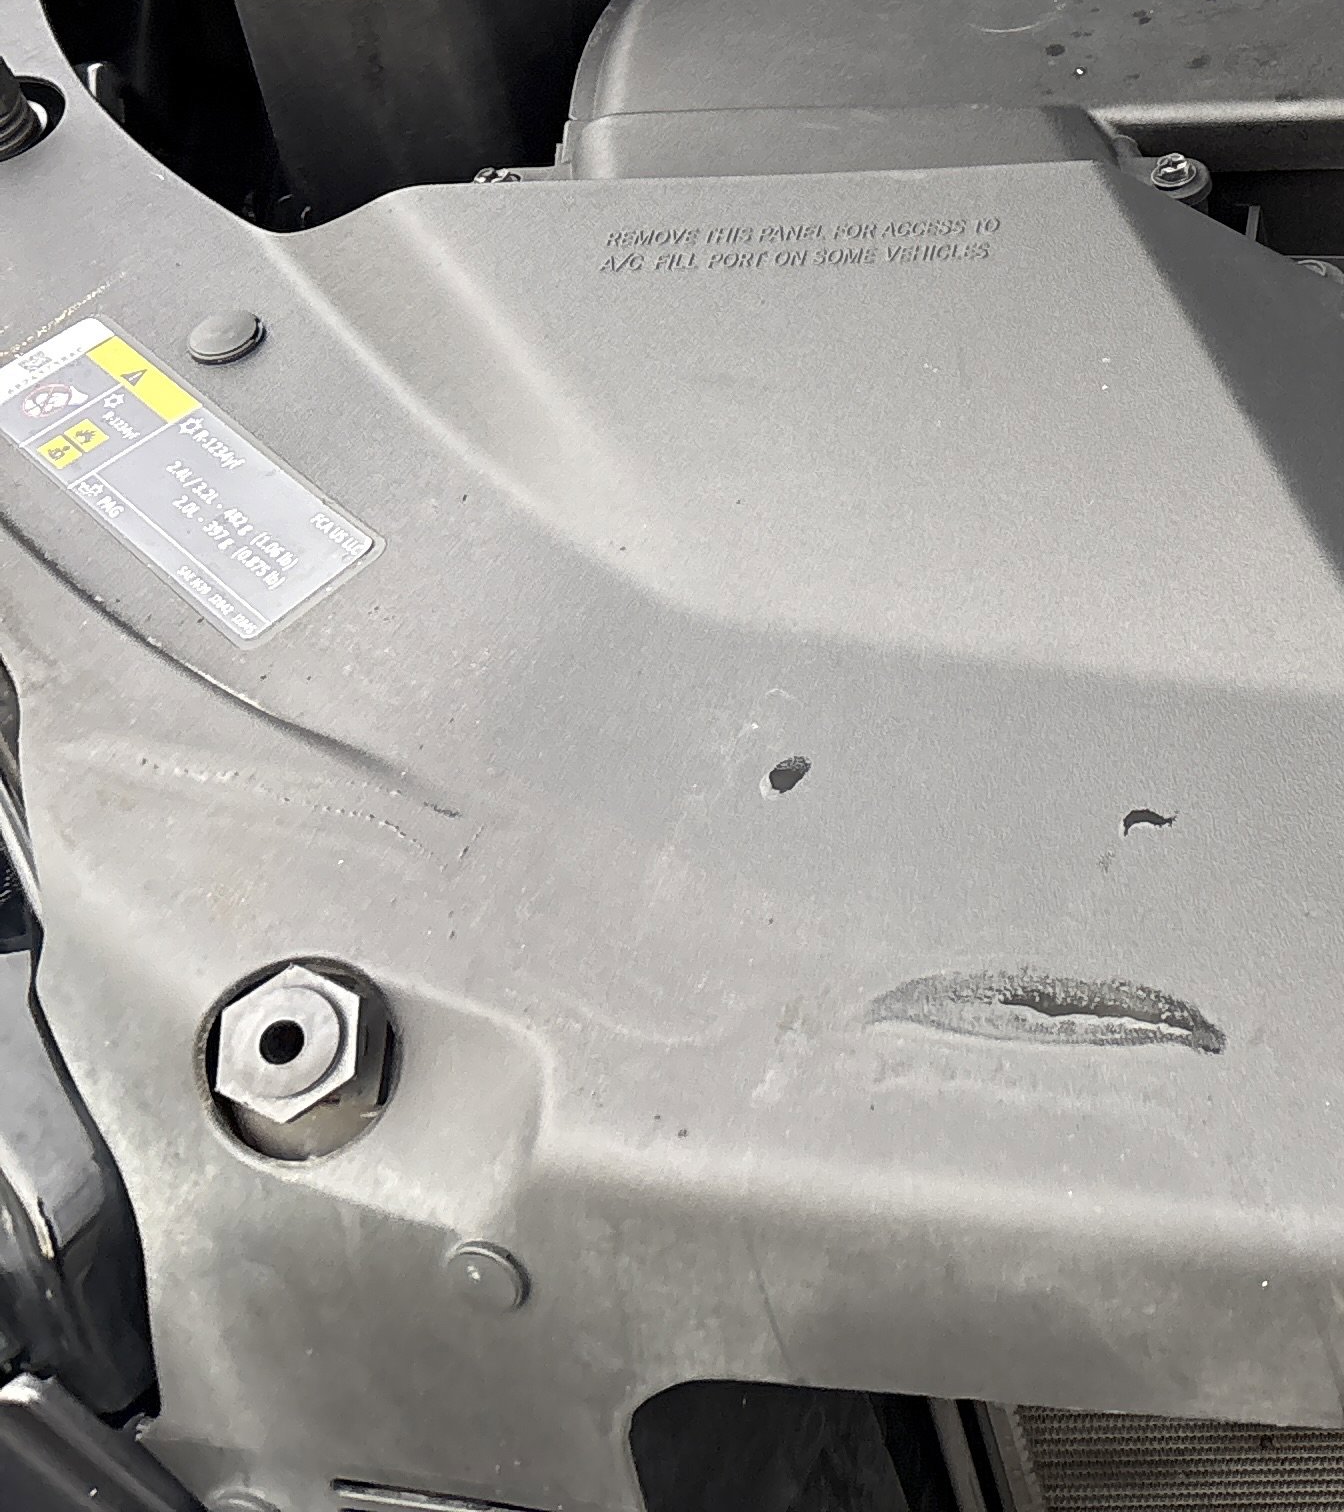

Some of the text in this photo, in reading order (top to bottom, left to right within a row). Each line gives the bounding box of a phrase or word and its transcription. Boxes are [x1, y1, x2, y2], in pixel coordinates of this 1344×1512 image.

[606, 217, 1001, 247] REMOVE THIS PANEL FOR ACCESS TO
[600, 241, 991, 272] A/C FILL PORT ON SOME VEHICLES
[192, 429, 246, 470] R-1234yf
[95, 495, 125, 519] PAG
[172, 494, 200, 518] 2.0L
[202, 520, 230, 540] 397
[309, 513, 365, 556] FCA US LLC
